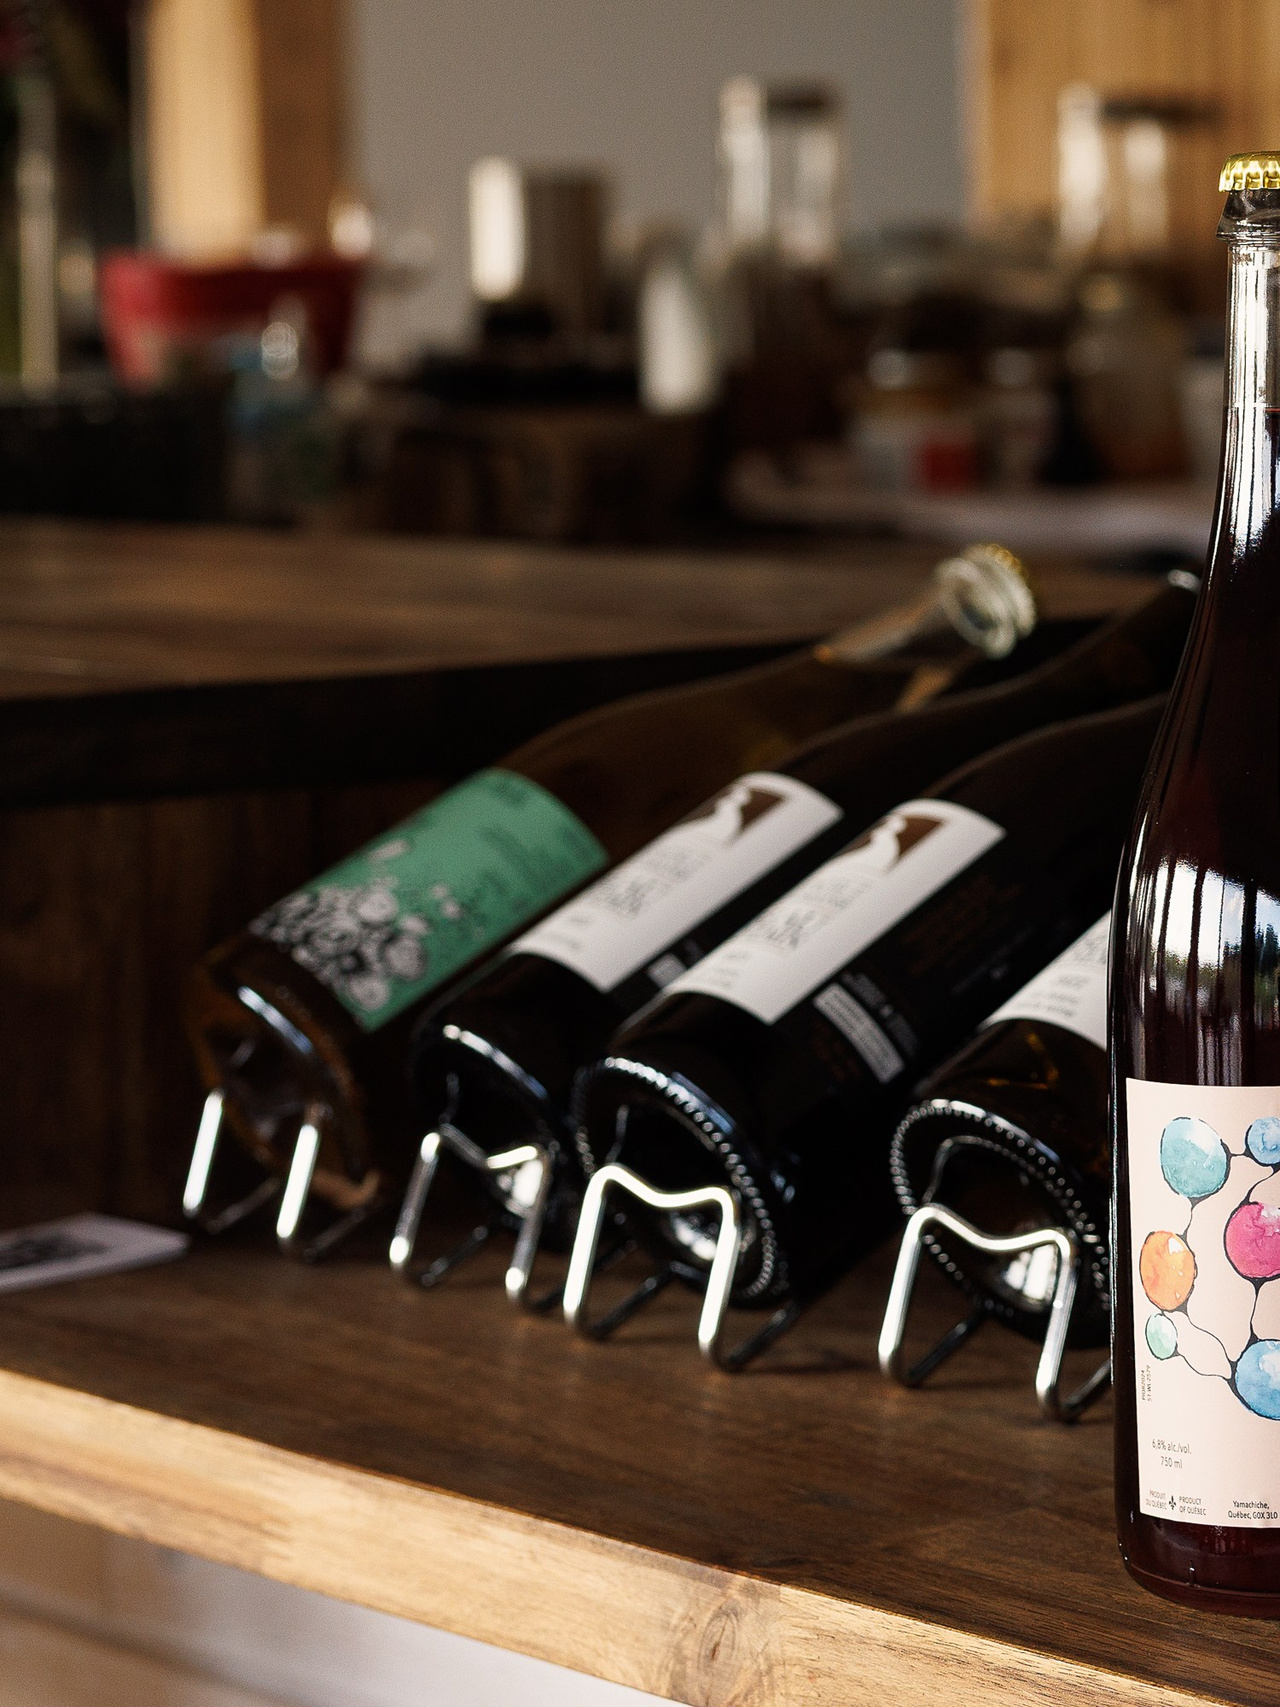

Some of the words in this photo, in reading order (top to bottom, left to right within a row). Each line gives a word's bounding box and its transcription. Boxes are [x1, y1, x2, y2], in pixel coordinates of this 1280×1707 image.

[1160, 1456, 1173, 1468] 750
[1174, 1459, 1183, 1469] ml
[1179, 1495, 1202, 1506] PRODUCT
[1233, 1500, 1270, 1510] Yamachiche,
